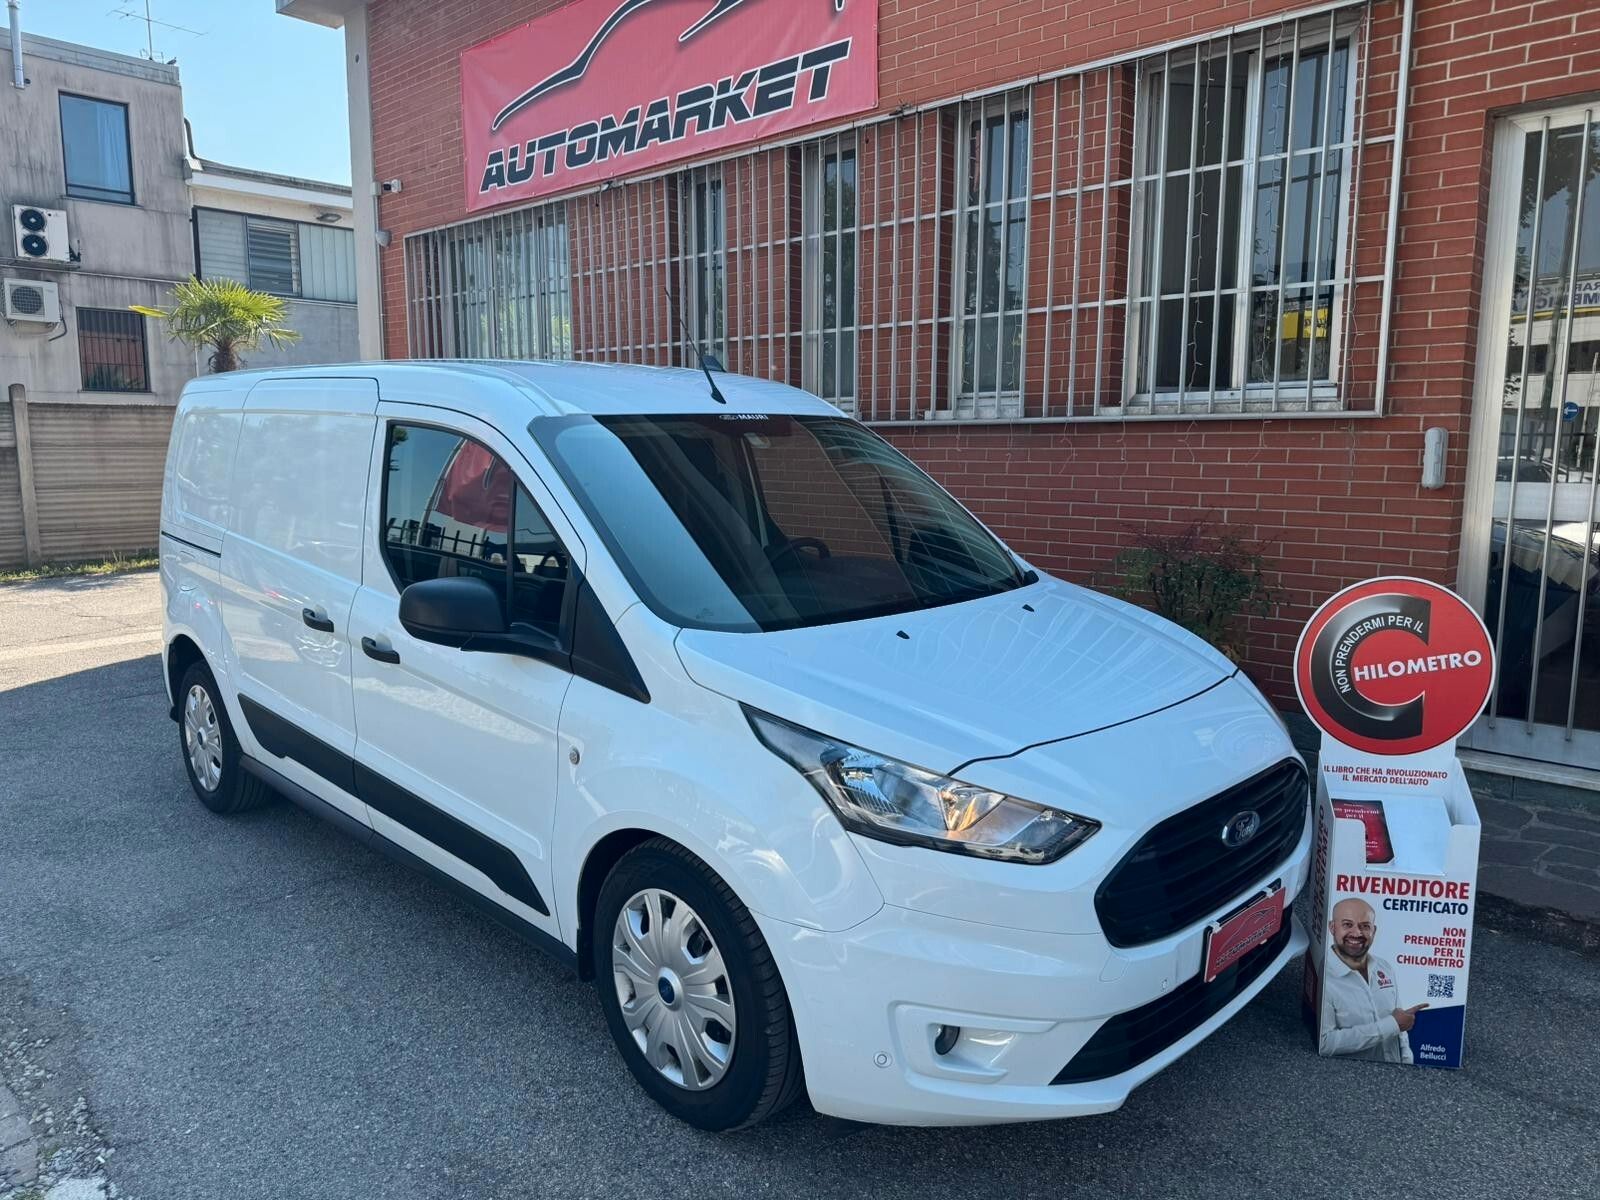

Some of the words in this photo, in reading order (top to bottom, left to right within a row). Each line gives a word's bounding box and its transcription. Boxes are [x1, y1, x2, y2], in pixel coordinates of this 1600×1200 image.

[479, 36, 853, 194] AUTOMARKET
[1388, 615, 1414, 630] PER
[1414, 620, 1425, 634] IL
[1335, 616, 1386, 667] PRENDERMI
[1335, 668, 1352, 694] NON
[1323, 765, 1331, 773] IL
[1332, 765, 1354, 774] LIBRO
[1355, 766, 1371, 775] CHE
[1372, 767, 1383, 776] HA
[1386, 768, 1448, 779] RIVOLUZIONATO
[1352, 775, 1388, 784] MERCATO
[1336, 874, 1470, 900] RIVENDITORE
[1383, 898, 1468, 915] CERTIFICATO
[1442, 927, 1467, 938] NON
[1404, 935, 1465, 948] PRENDERMI
[1434, 947, 1454, 958] PER
[1455, 948, 1465, 959] IL
[1396, 954, 1464, 969] CHILOMETRO
[1420, 1043, 1446, 1053] Alfredo
[1420, 1052, 1447, 1061] Bellucci
